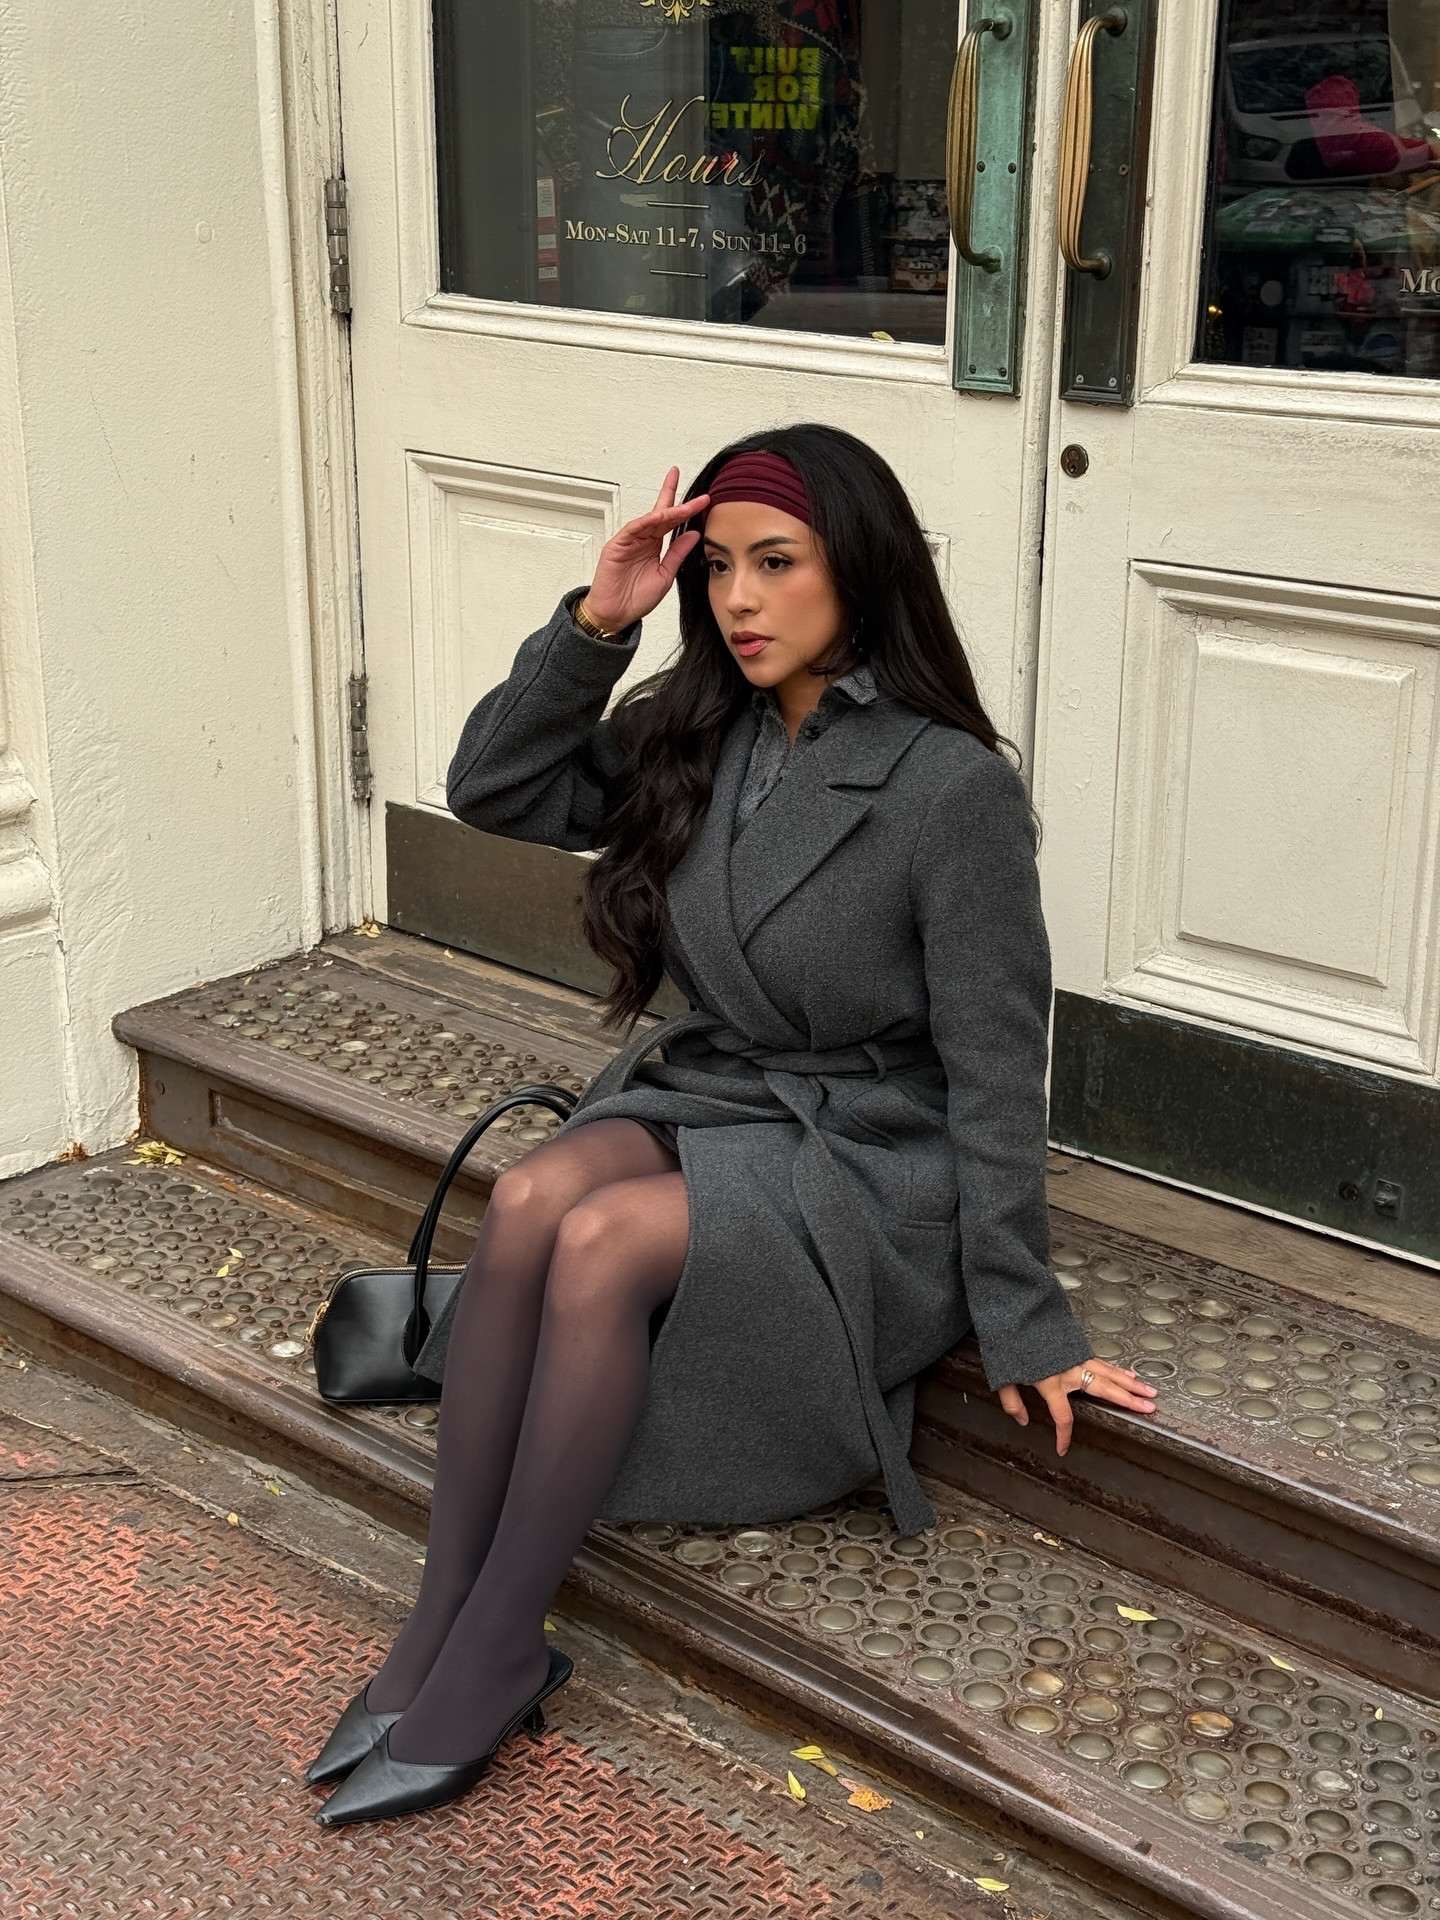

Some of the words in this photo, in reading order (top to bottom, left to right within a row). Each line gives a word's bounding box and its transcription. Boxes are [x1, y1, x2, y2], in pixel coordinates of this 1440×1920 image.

[596, 94, 766, 185] Hours
[655, 226, 705, 251] 11-7,
[757, 232, 807, 255] 11-6
